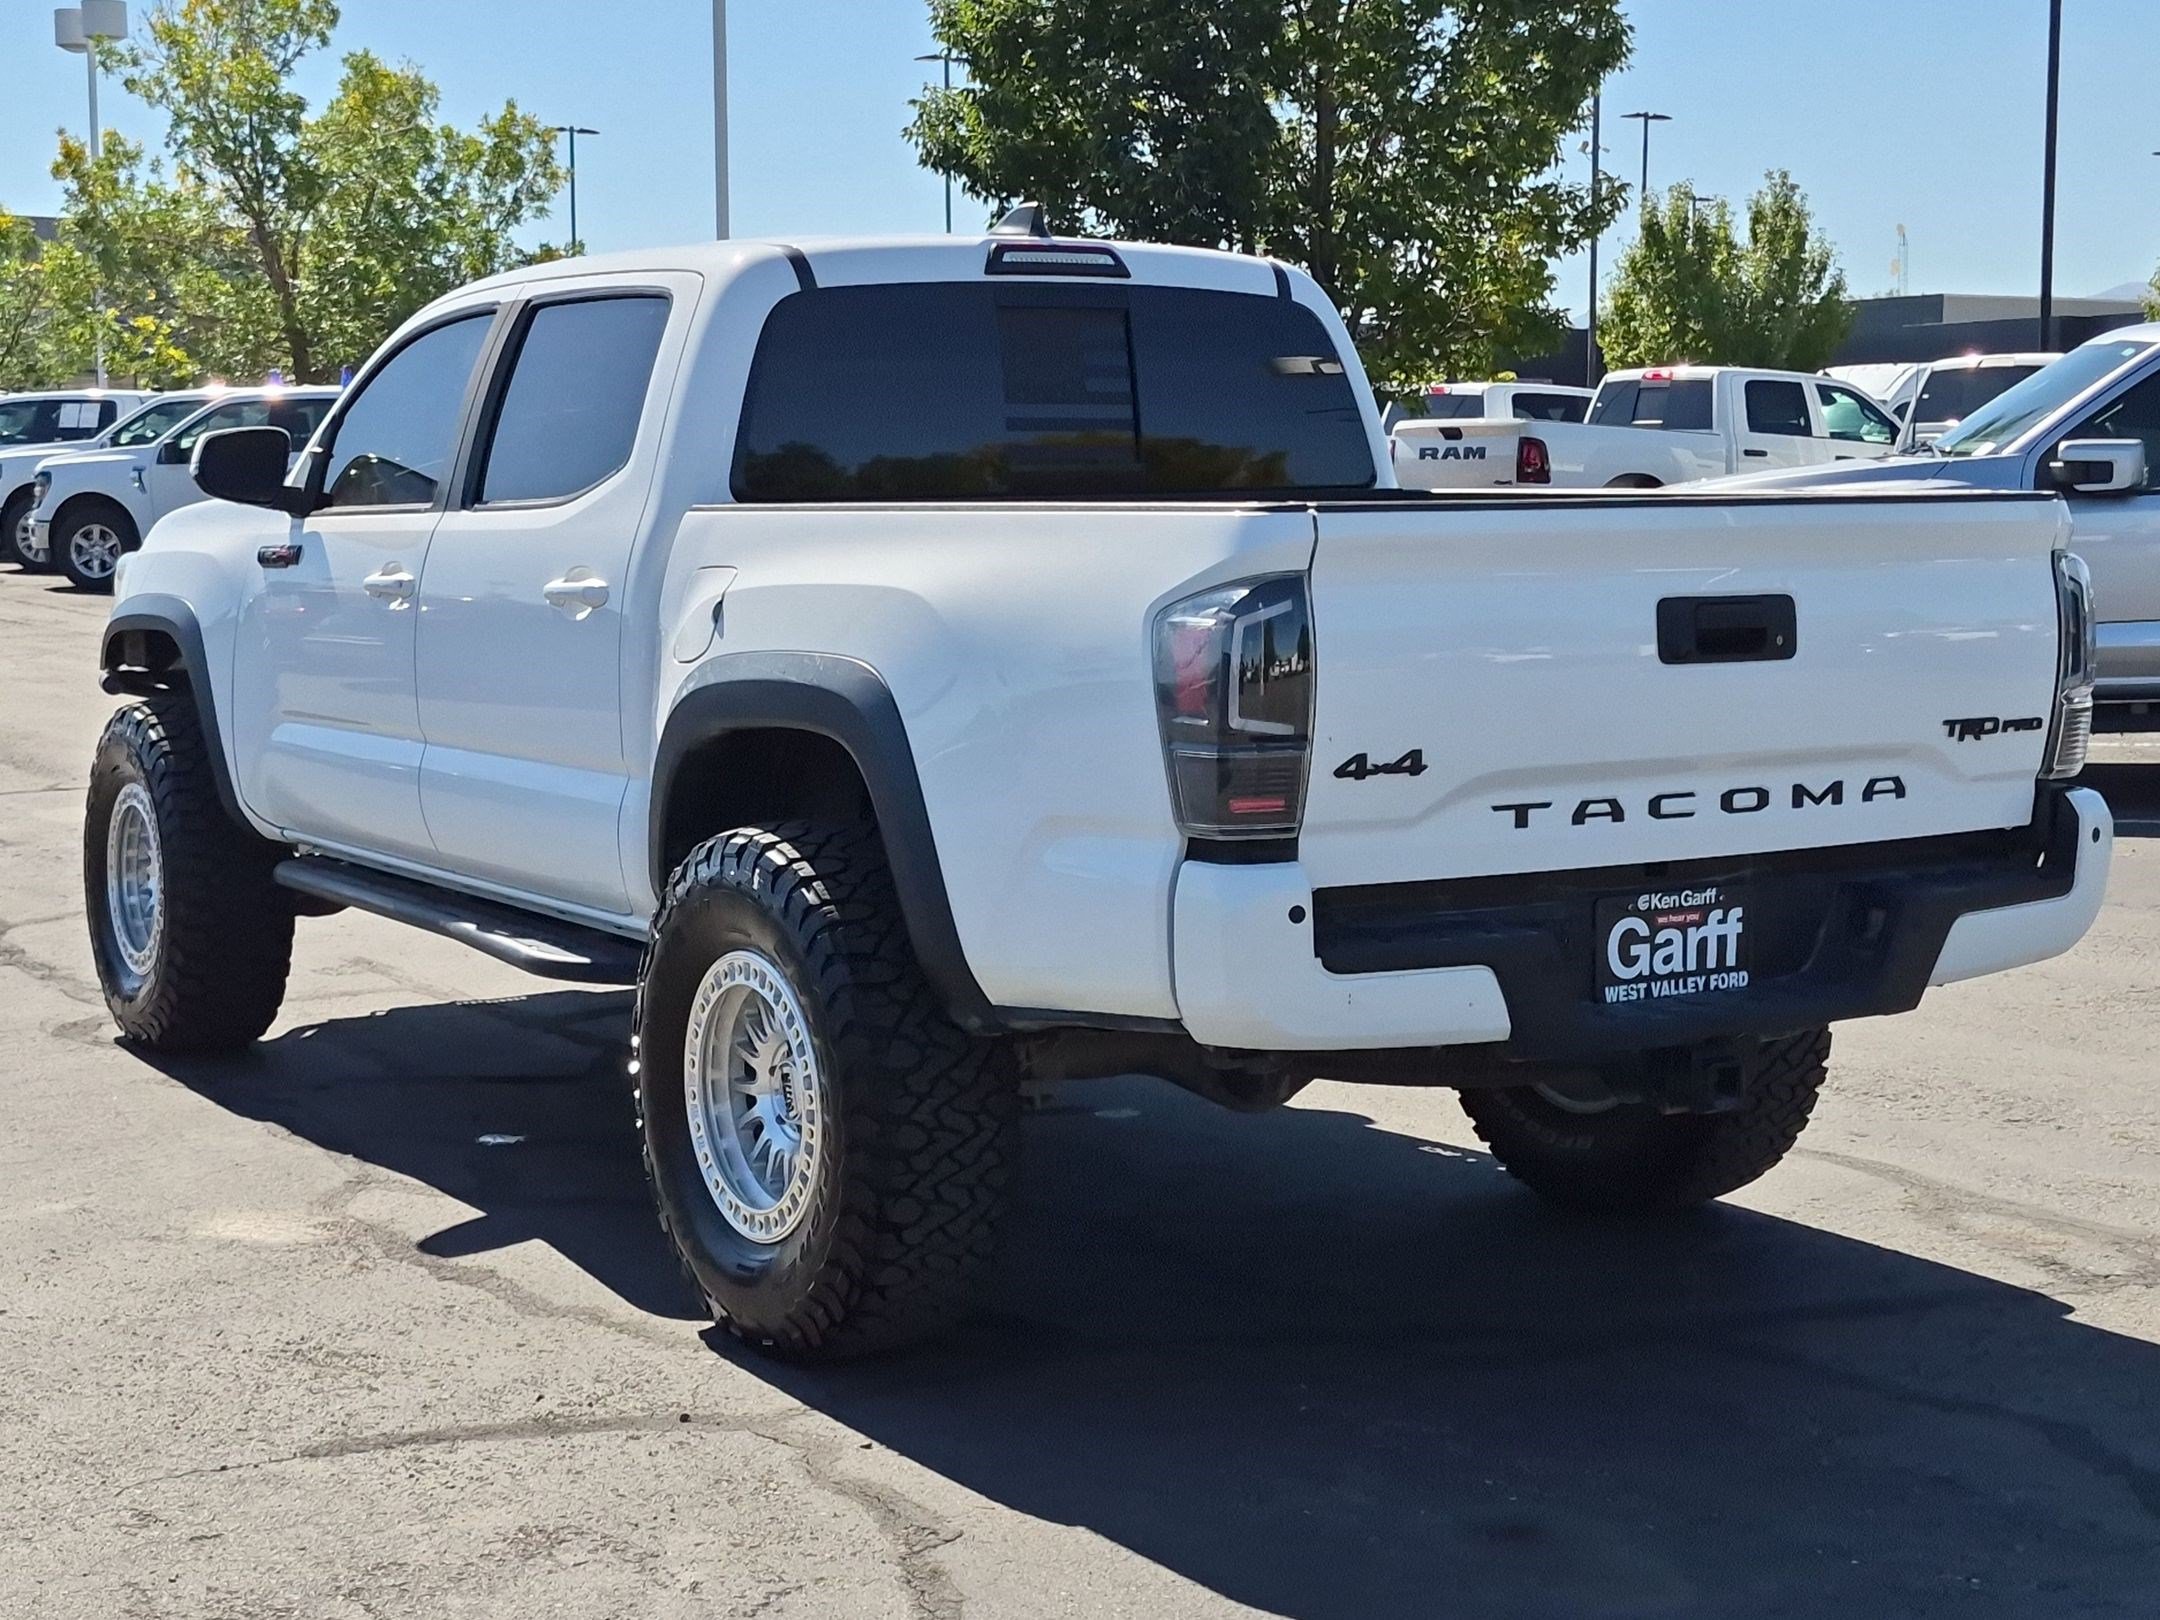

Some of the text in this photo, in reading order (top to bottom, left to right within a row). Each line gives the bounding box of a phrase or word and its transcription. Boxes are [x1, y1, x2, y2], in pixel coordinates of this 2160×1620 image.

[1419, 446, 1486, 460] RAM
[1942, 717, 2000, 742] TRD
[1333, 749, 1428, 780] 4x4
[1491, 776, 1906, 829] TACOMA
[1651, 887, 1717, 910] Ken Garff
[1607, 906, 1743, 980] Garff
[1605, 970, 1749, 1004] WEST VALLEY FORD
